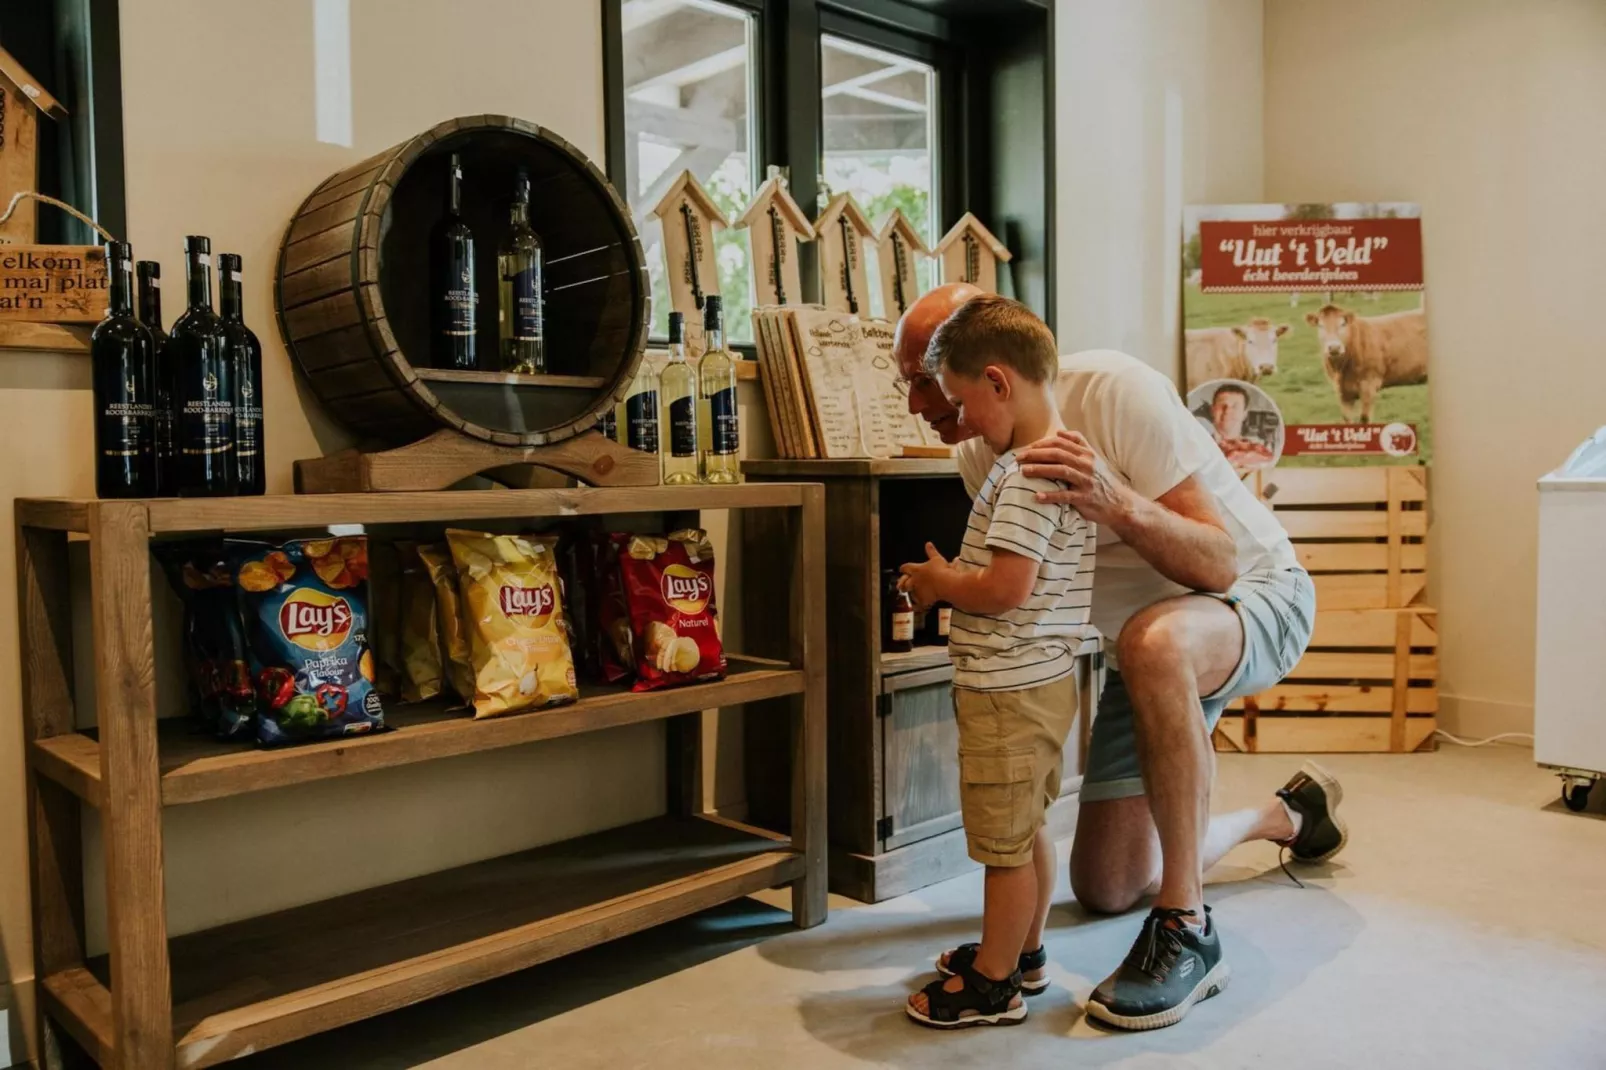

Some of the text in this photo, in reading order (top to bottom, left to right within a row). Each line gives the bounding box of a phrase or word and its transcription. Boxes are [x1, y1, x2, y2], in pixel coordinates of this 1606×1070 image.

[1253, 224, 1277, 236] hier
[0, 252, 81, 269] elkom
[4, 272, 109, 293] maj plat
[667, 575, 708, 602] Lay's
[504, 586, 552, 616] Lay's
[287, 601, 349, 637] Lay's
[679, 618, 709, 628] Naturel
[304, 656, 348, 671] Paprika
[309, 669, 344, 678] Flavour
